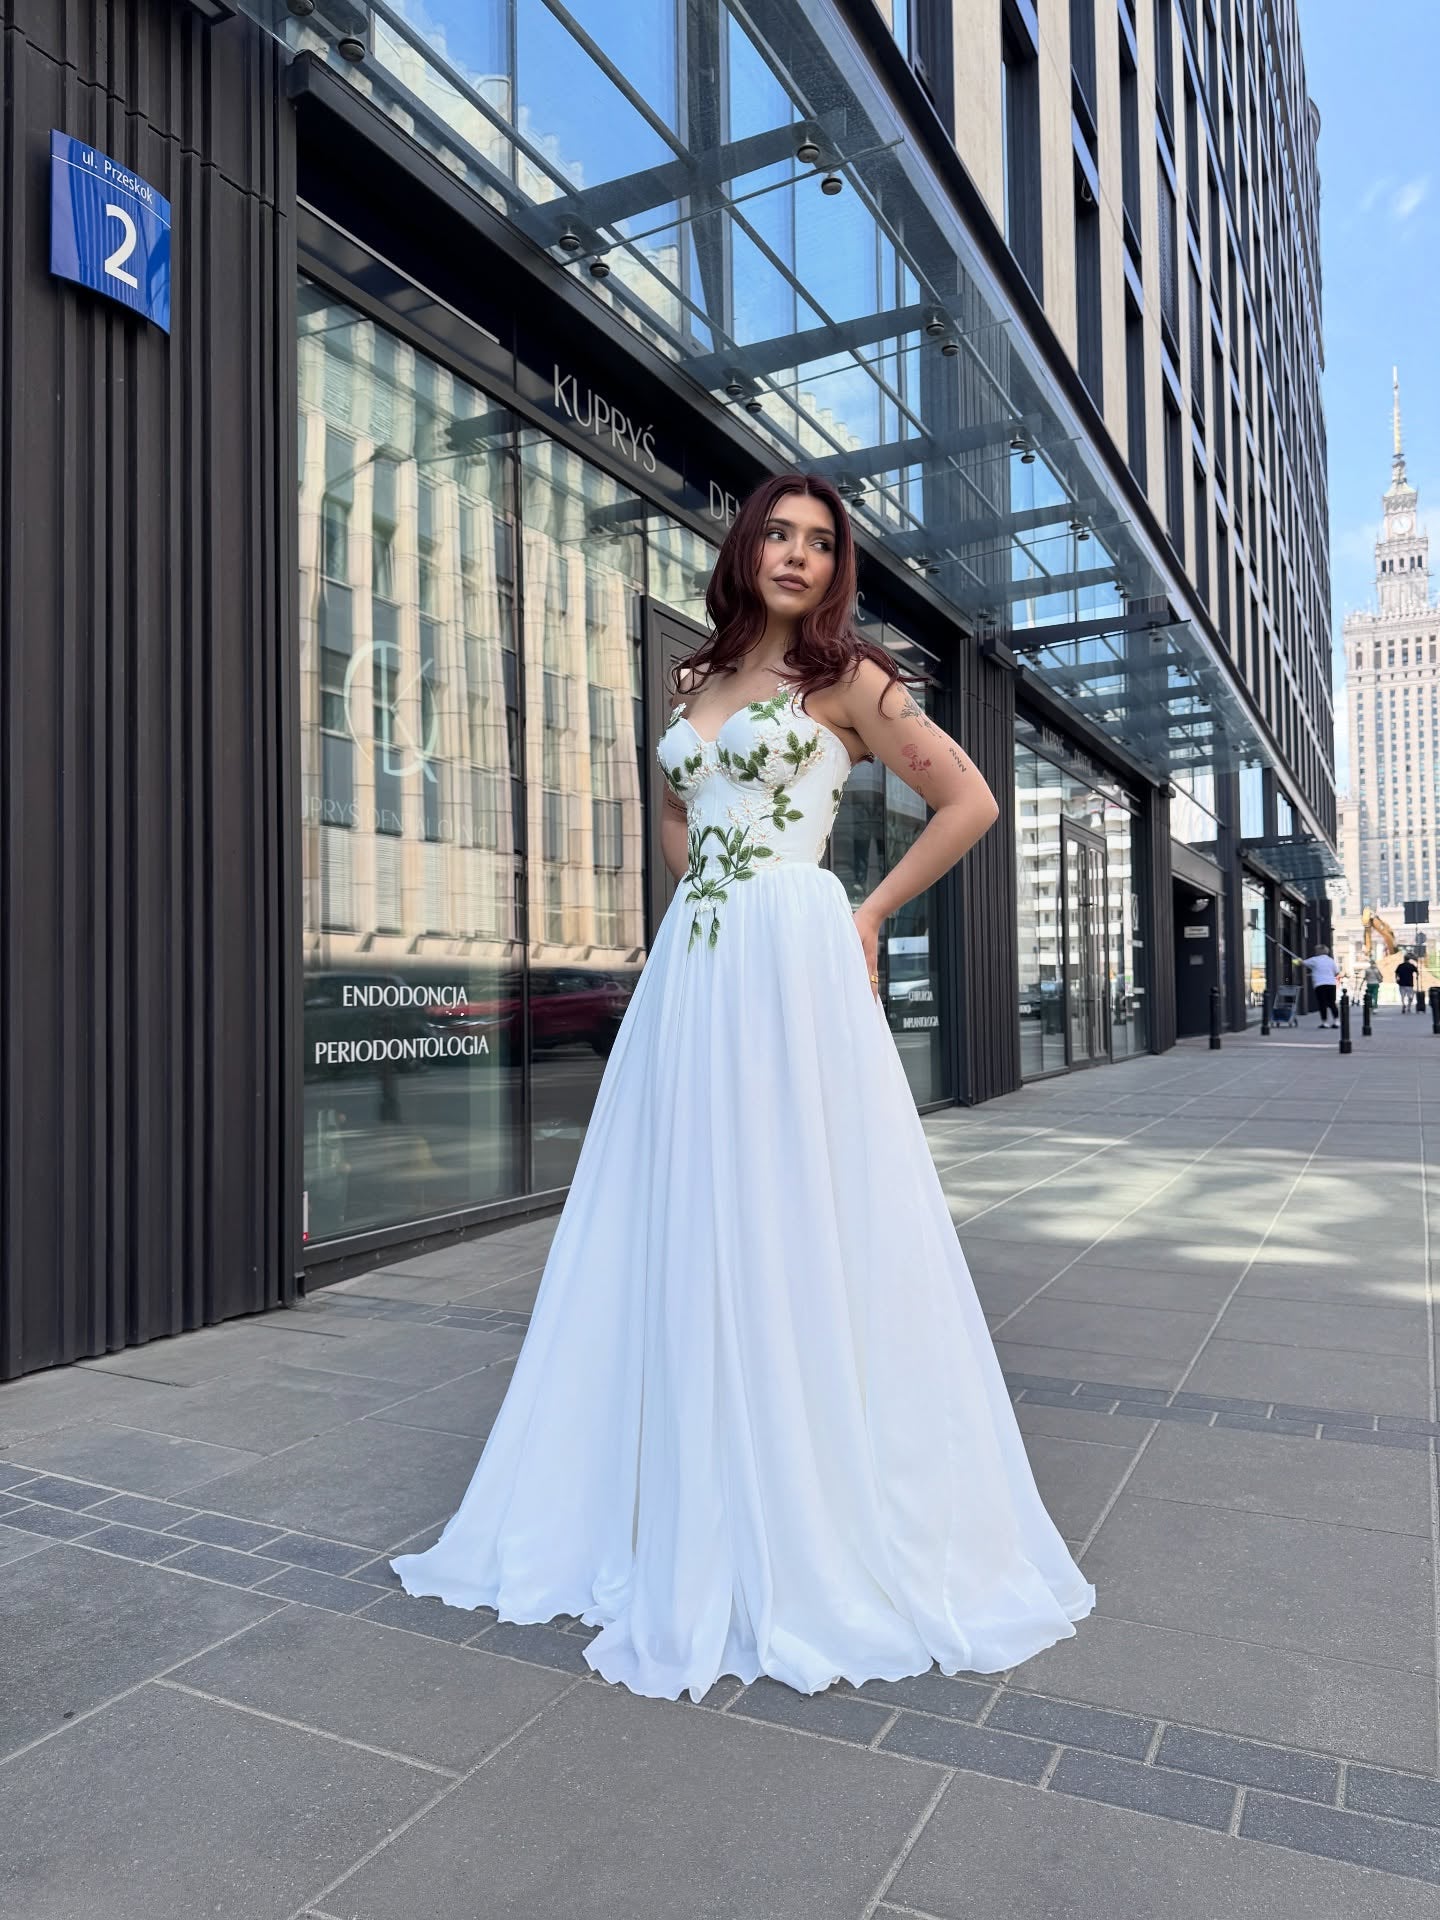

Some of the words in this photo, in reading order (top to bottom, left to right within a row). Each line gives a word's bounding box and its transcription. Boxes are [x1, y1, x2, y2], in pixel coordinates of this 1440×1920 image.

[82, 151, 97, 169] ul.
[104, 159, 153, 204] Przeskok
[104, 203, 138, 289] 2
[554, 363, 656, 473] KUPRYŚ
[342, 985, 469, 1009] ENDODONCJA
[314, 1034, 490, 1065] PERIODONTOLOGIA
